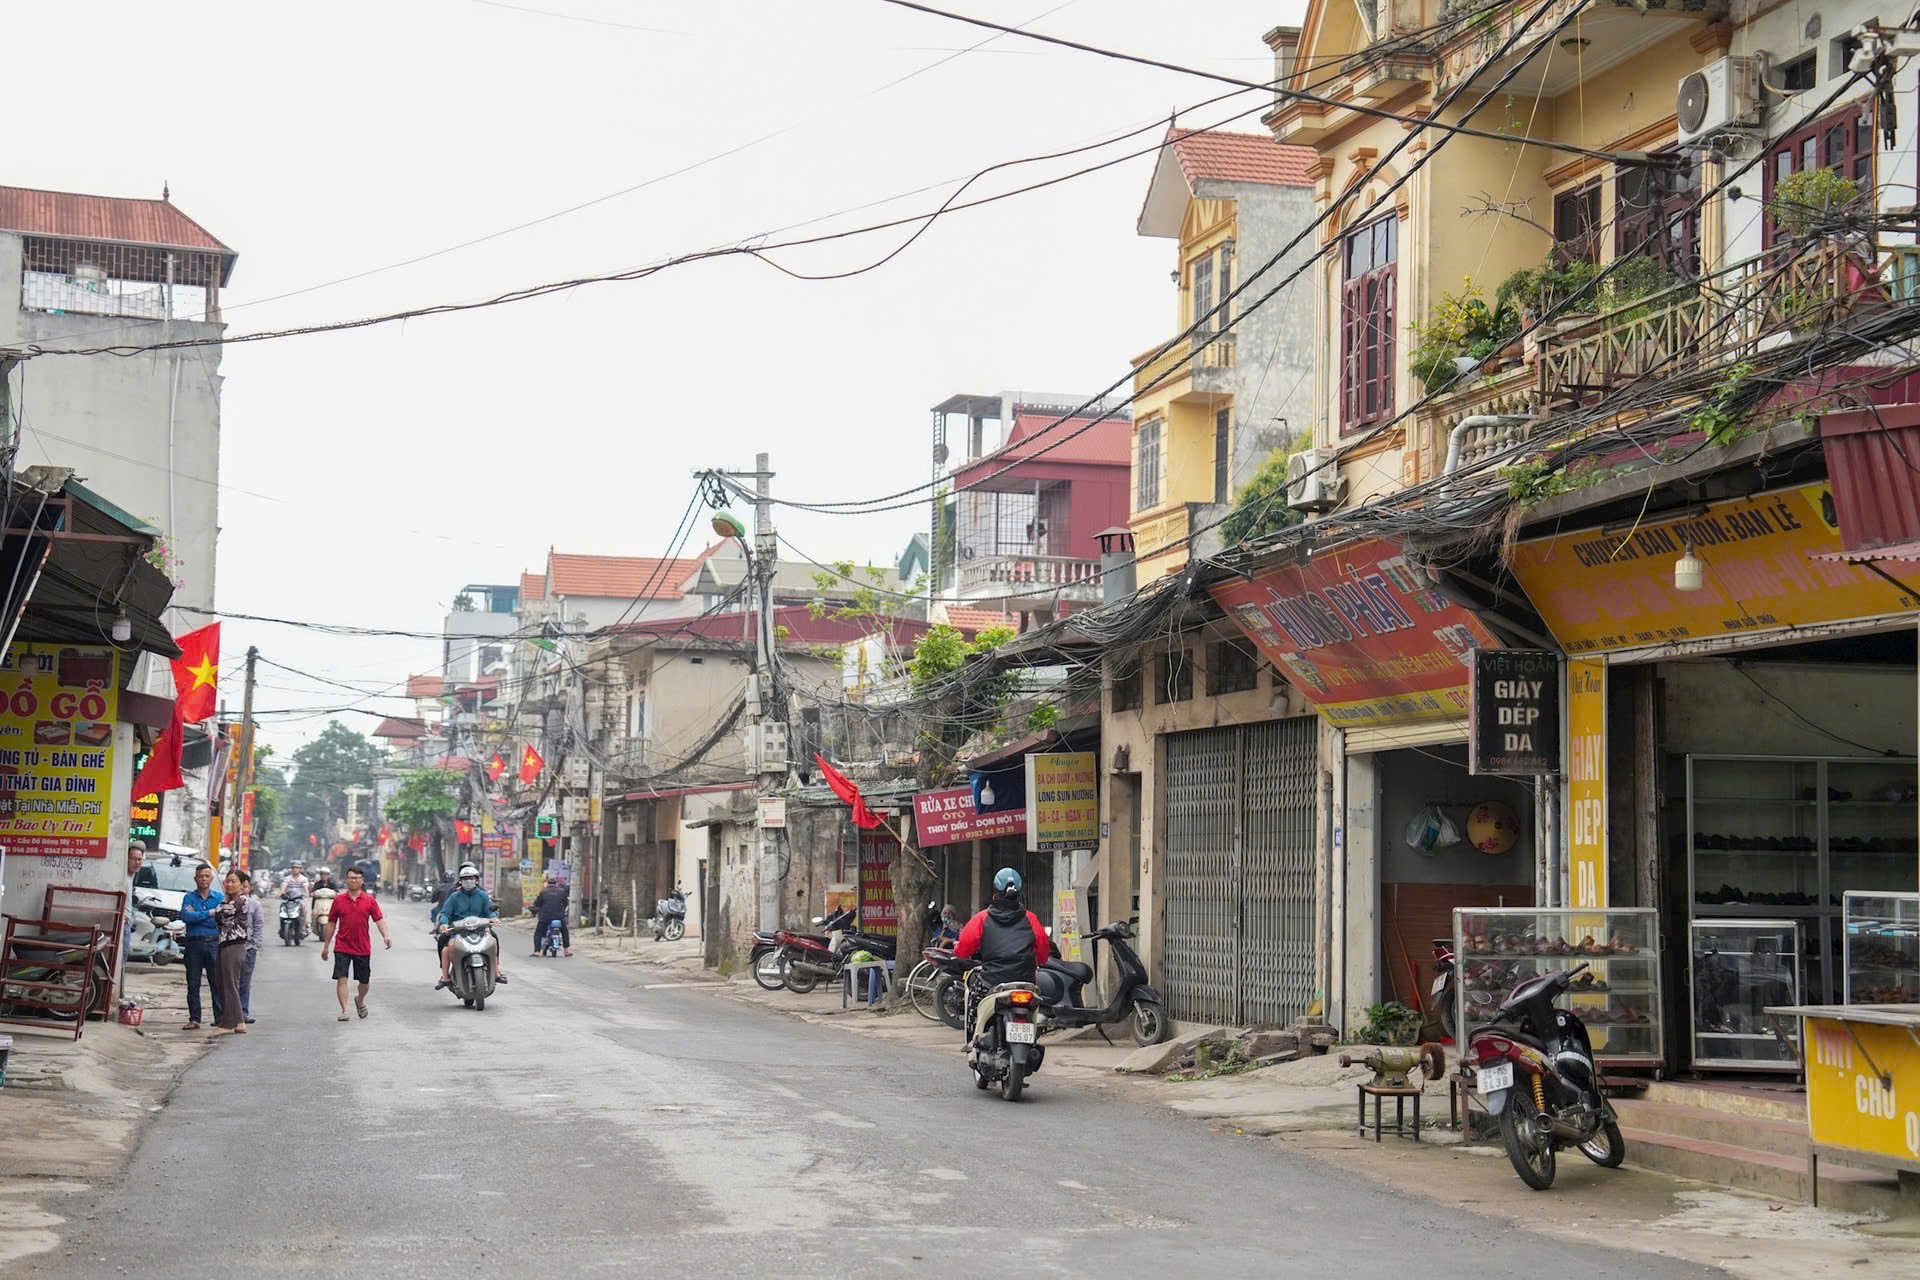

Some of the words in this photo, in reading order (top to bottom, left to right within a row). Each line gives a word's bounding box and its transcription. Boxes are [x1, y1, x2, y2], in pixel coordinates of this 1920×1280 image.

[1768, 496, 1802, 531] LẺ
[1322, 562, 1417, 638] PHÁT
[1494, 675, 1543, 699] GIÀY
[50, 678, 106, 720] GỖ
[1498, 703, 1539, 726] DÉP
[1504, 733, 1533, 752] DA
[1572, 727, 1600, 781] GIÀY
[25, 747, 40, 766] TỦ
[52, 750, 78, 767] BÀN
[81, 750, 106, 768] GHẾ
[7, 771, 38, 790] THẤT
[41, 776, 61, 791] GIA
[65, 775, 96, 792] ĐÌNH
[33, 799, 54, 813] Nhà
[82, 800, 102, 814] Phí
[920, 795, 942, 814] RỬA
[944, 796, 957, 811] XE
[927, 825, 948, 834] THAY
[997, 814, 1012, 825] NỘI
[1575, 790, 1600, 845] DÉP
[1578, 861, 1597, 908] DA
